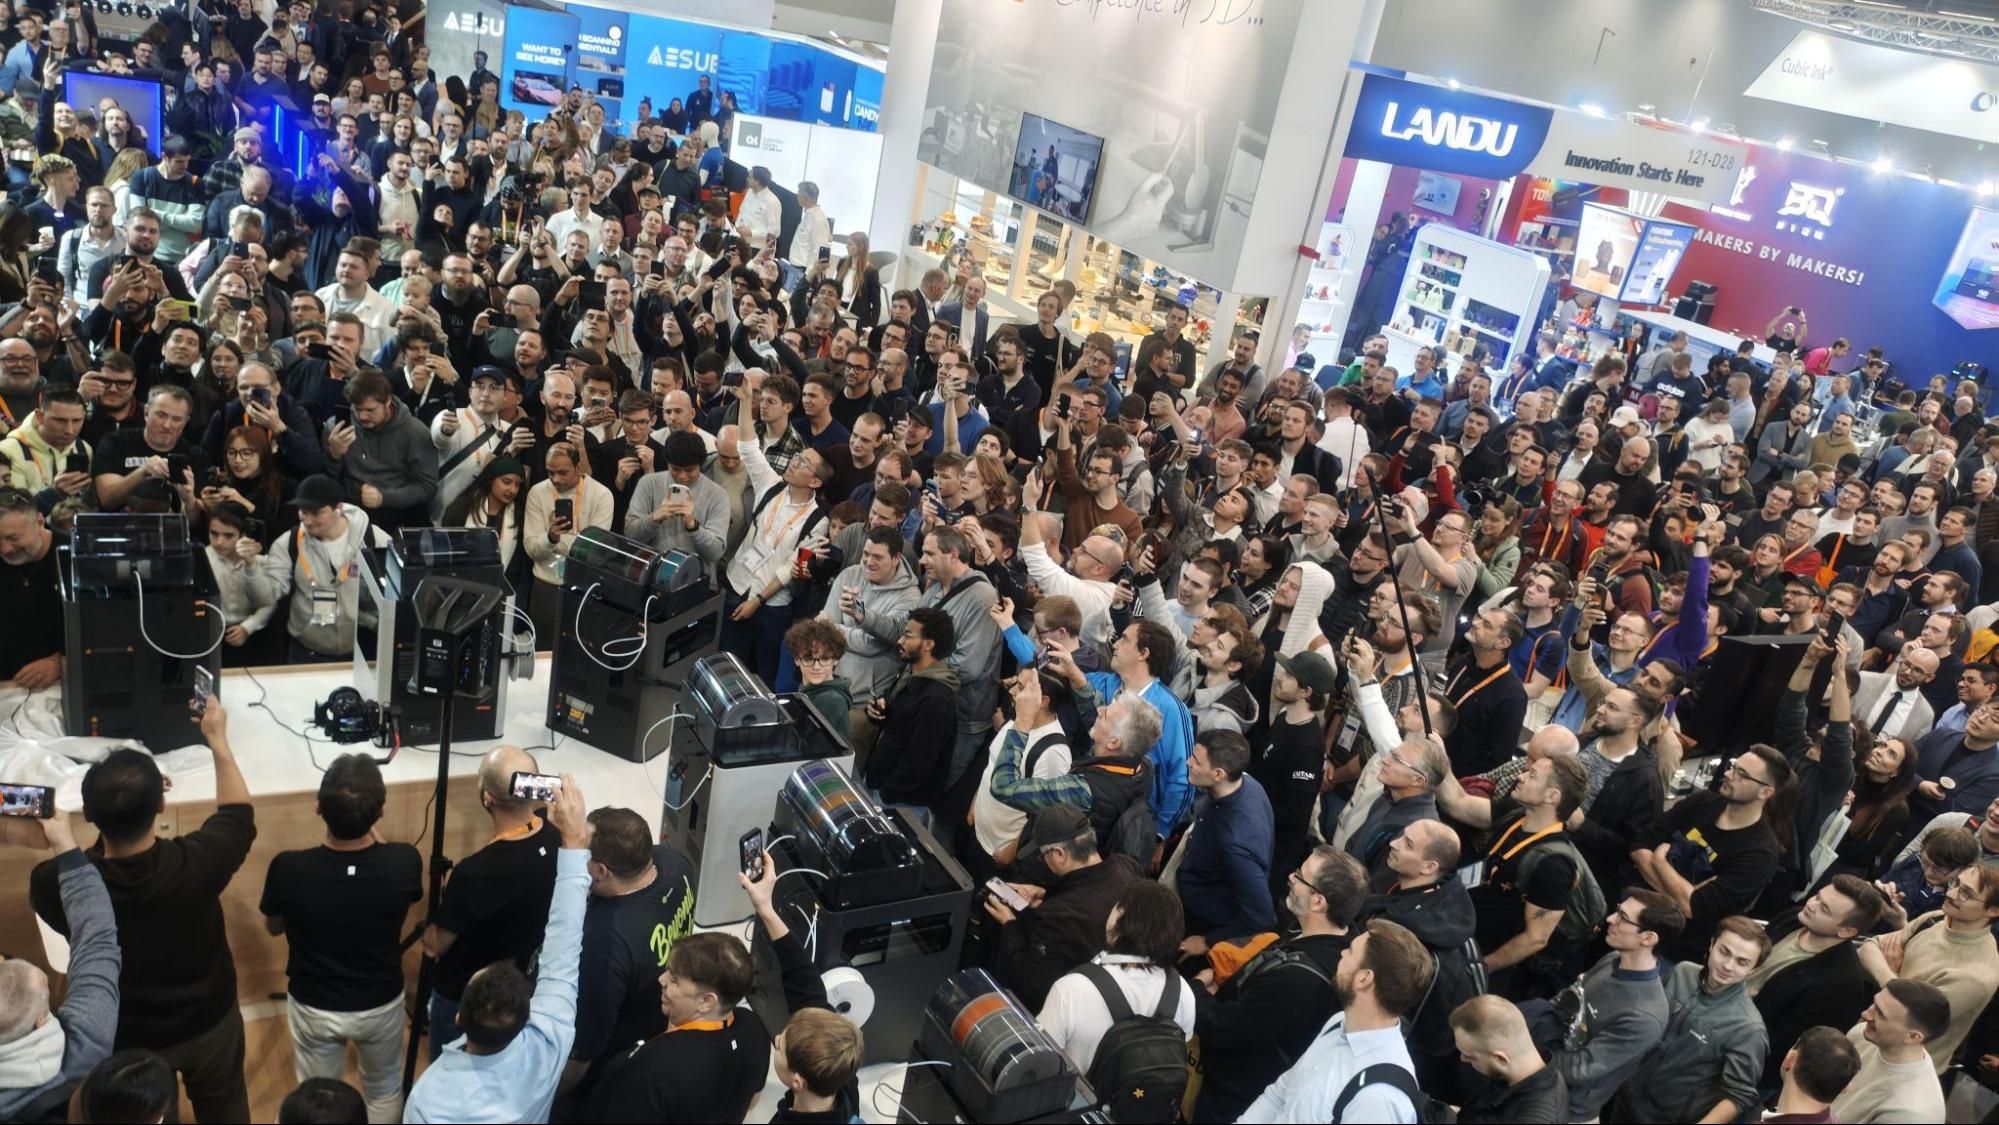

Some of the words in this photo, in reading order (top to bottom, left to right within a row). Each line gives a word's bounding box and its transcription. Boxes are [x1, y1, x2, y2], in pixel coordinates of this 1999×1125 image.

[516, 52, 534, 63] SEE
[535, 55, 567, 67] MORE?
[521, 42, 548, 55] WANT
[549, 46, 562, 57] TO
[1781, 57, 1808, 77] Cubic
[1381, 102, 1519, 157] LANDU
[1565, 150, 1635, 177] Innovation
[1636, 162, 1674, 184] Starts
[1675, 169, 1705, 188] Here
[1687, 149, 1736, 171] 121-D28
[1758, 245, 1782, 262] BY
[1786, 253, 1866, 286] MAKERS!
[1656, 382, 1686, 398] adidas
